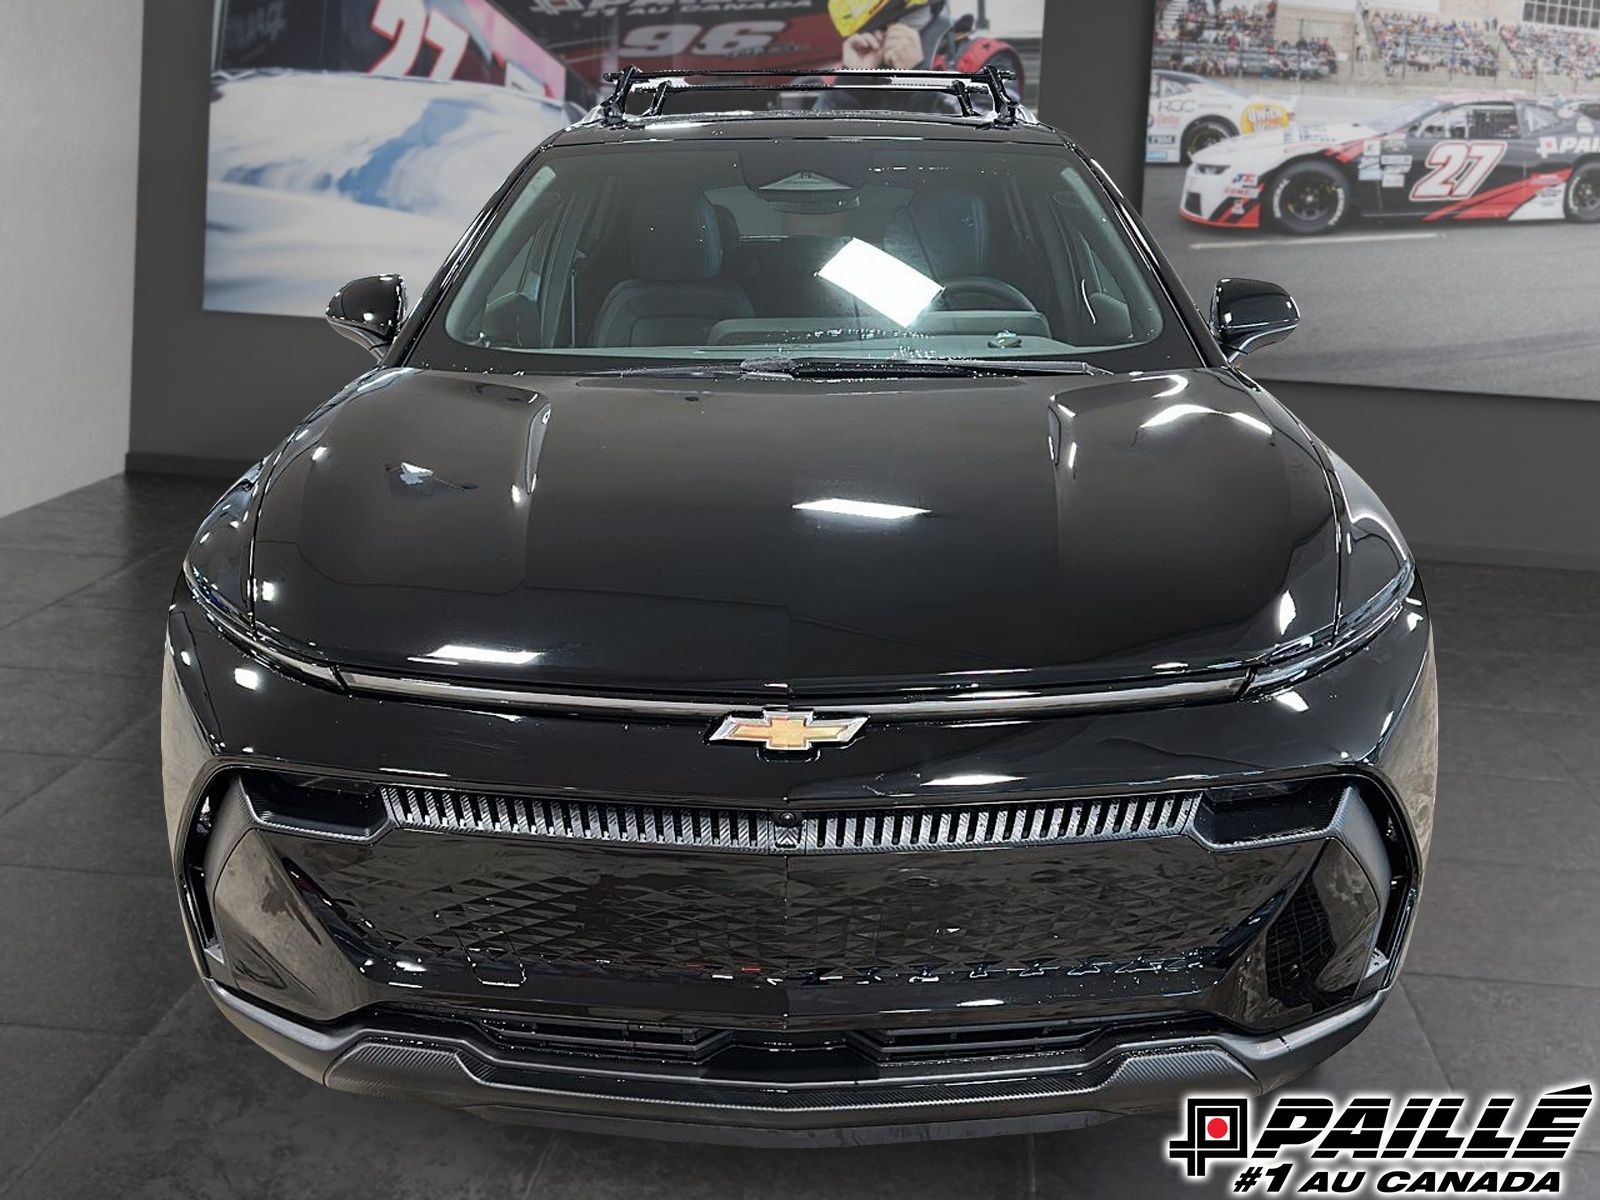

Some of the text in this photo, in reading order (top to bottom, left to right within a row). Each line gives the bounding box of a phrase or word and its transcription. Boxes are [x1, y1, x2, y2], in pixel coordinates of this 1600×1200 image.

[680, 1, 812, 12] CANADA
[620, 21, 785, 57] 96
[1409, 140, 1508, 201] 27
